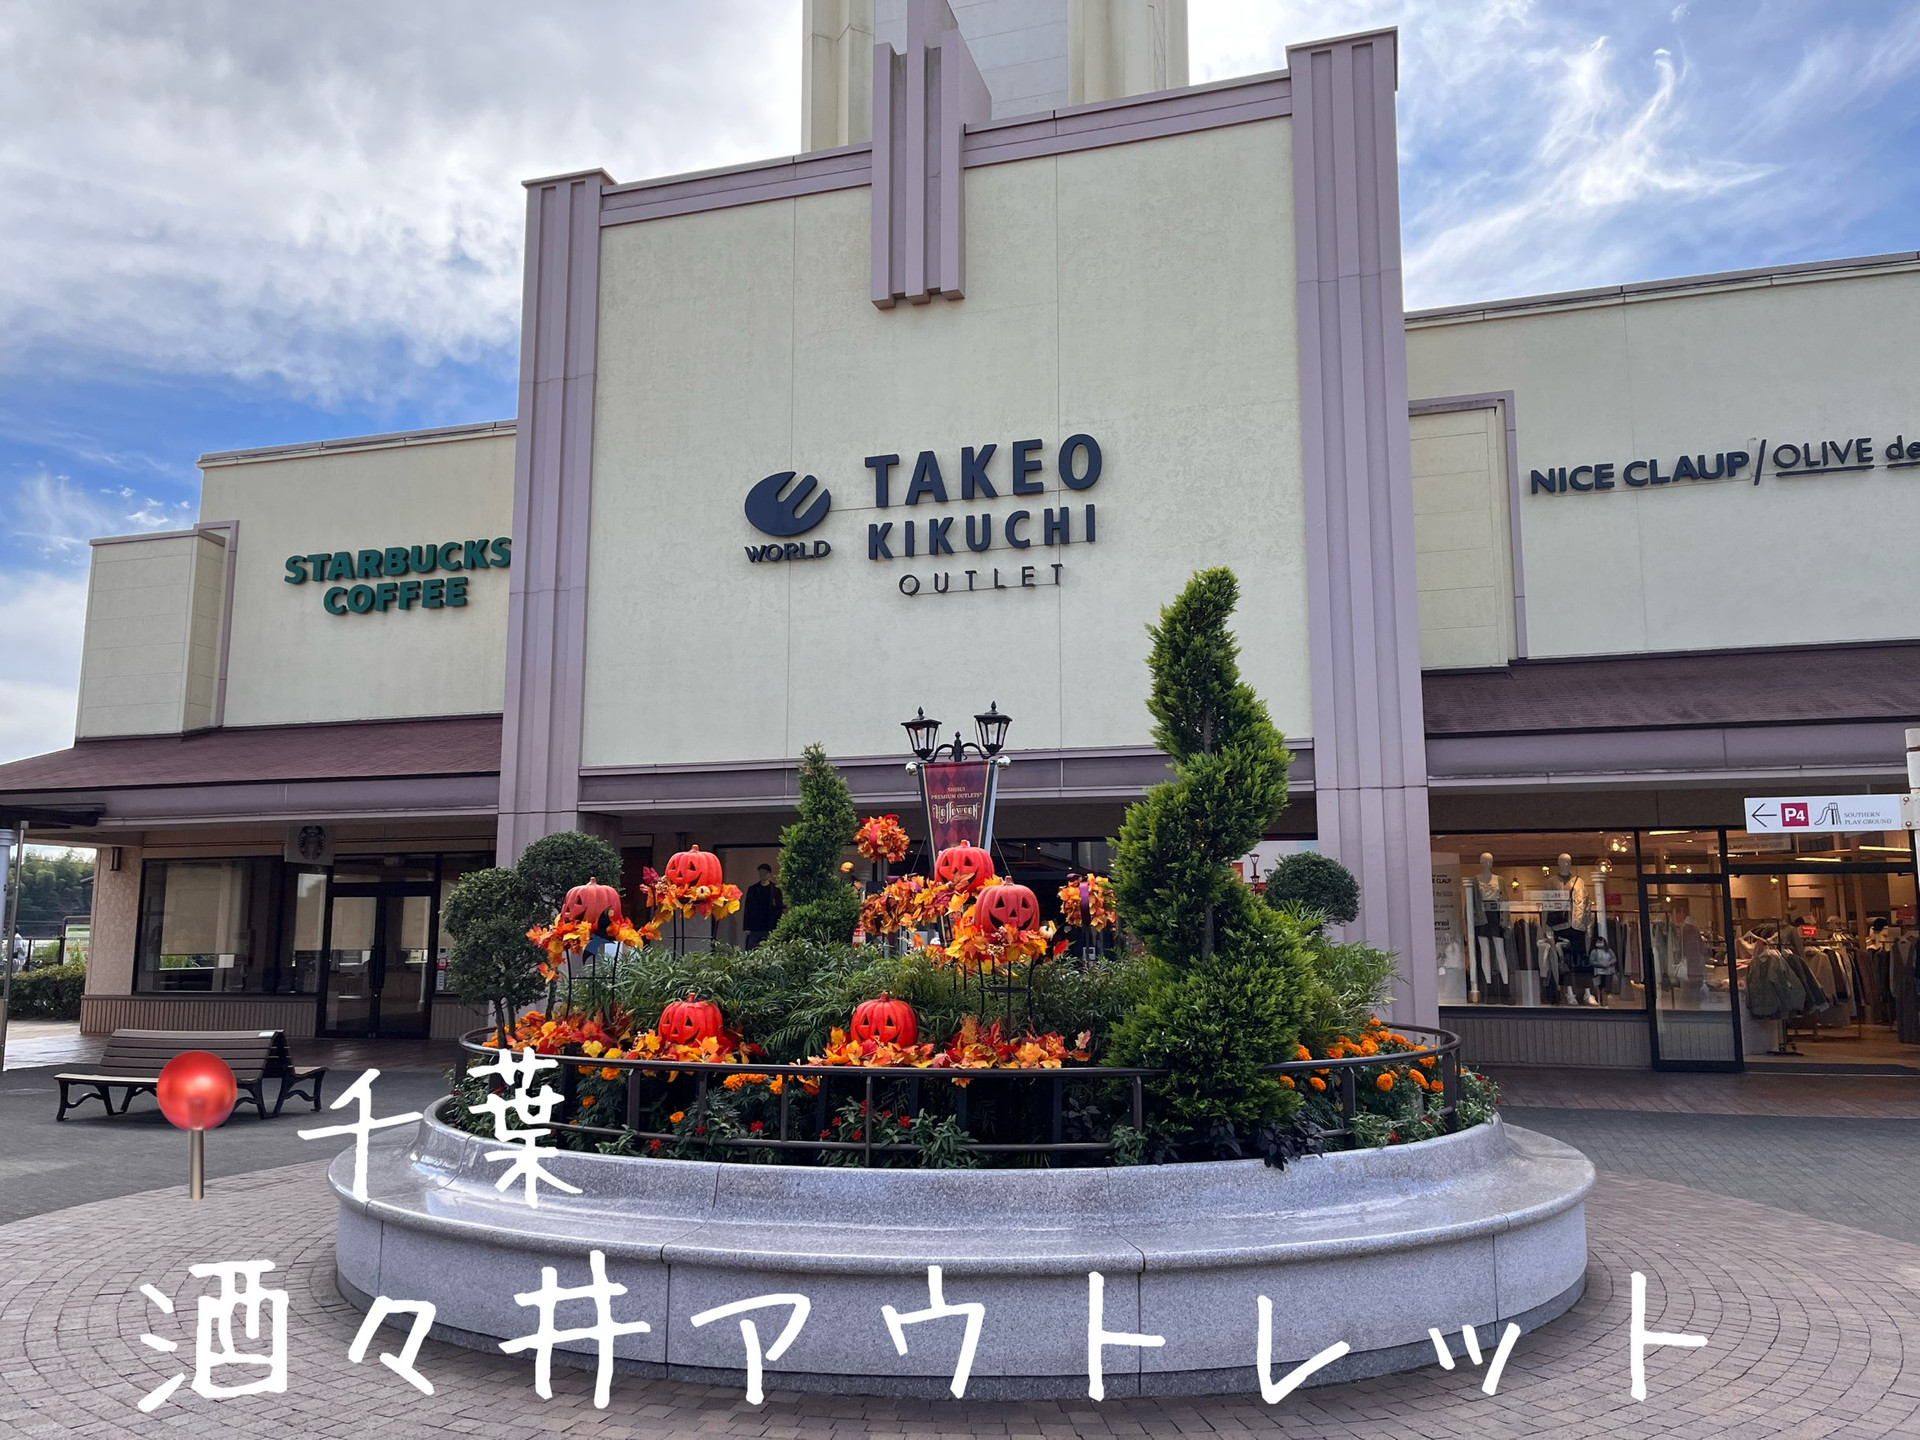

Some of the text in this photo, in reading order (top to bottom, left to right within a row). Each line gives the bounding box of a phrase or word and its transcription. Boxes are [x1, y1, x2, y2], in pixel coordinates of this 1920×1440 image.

[864, 433, 1102, 508] TAKEO
[1530, 463, 1615, 495] NICE
[868, 503, 1096, 560] KIKUCHI
[284, 537, 512, 585] STARBUCKS
[744, 540, 832, 563] WORLD
[324, 576, 468, 616] COFFEE
[898, 563, 1063, 596] OUTLET
[1784, 807, 1806, 822] P4
